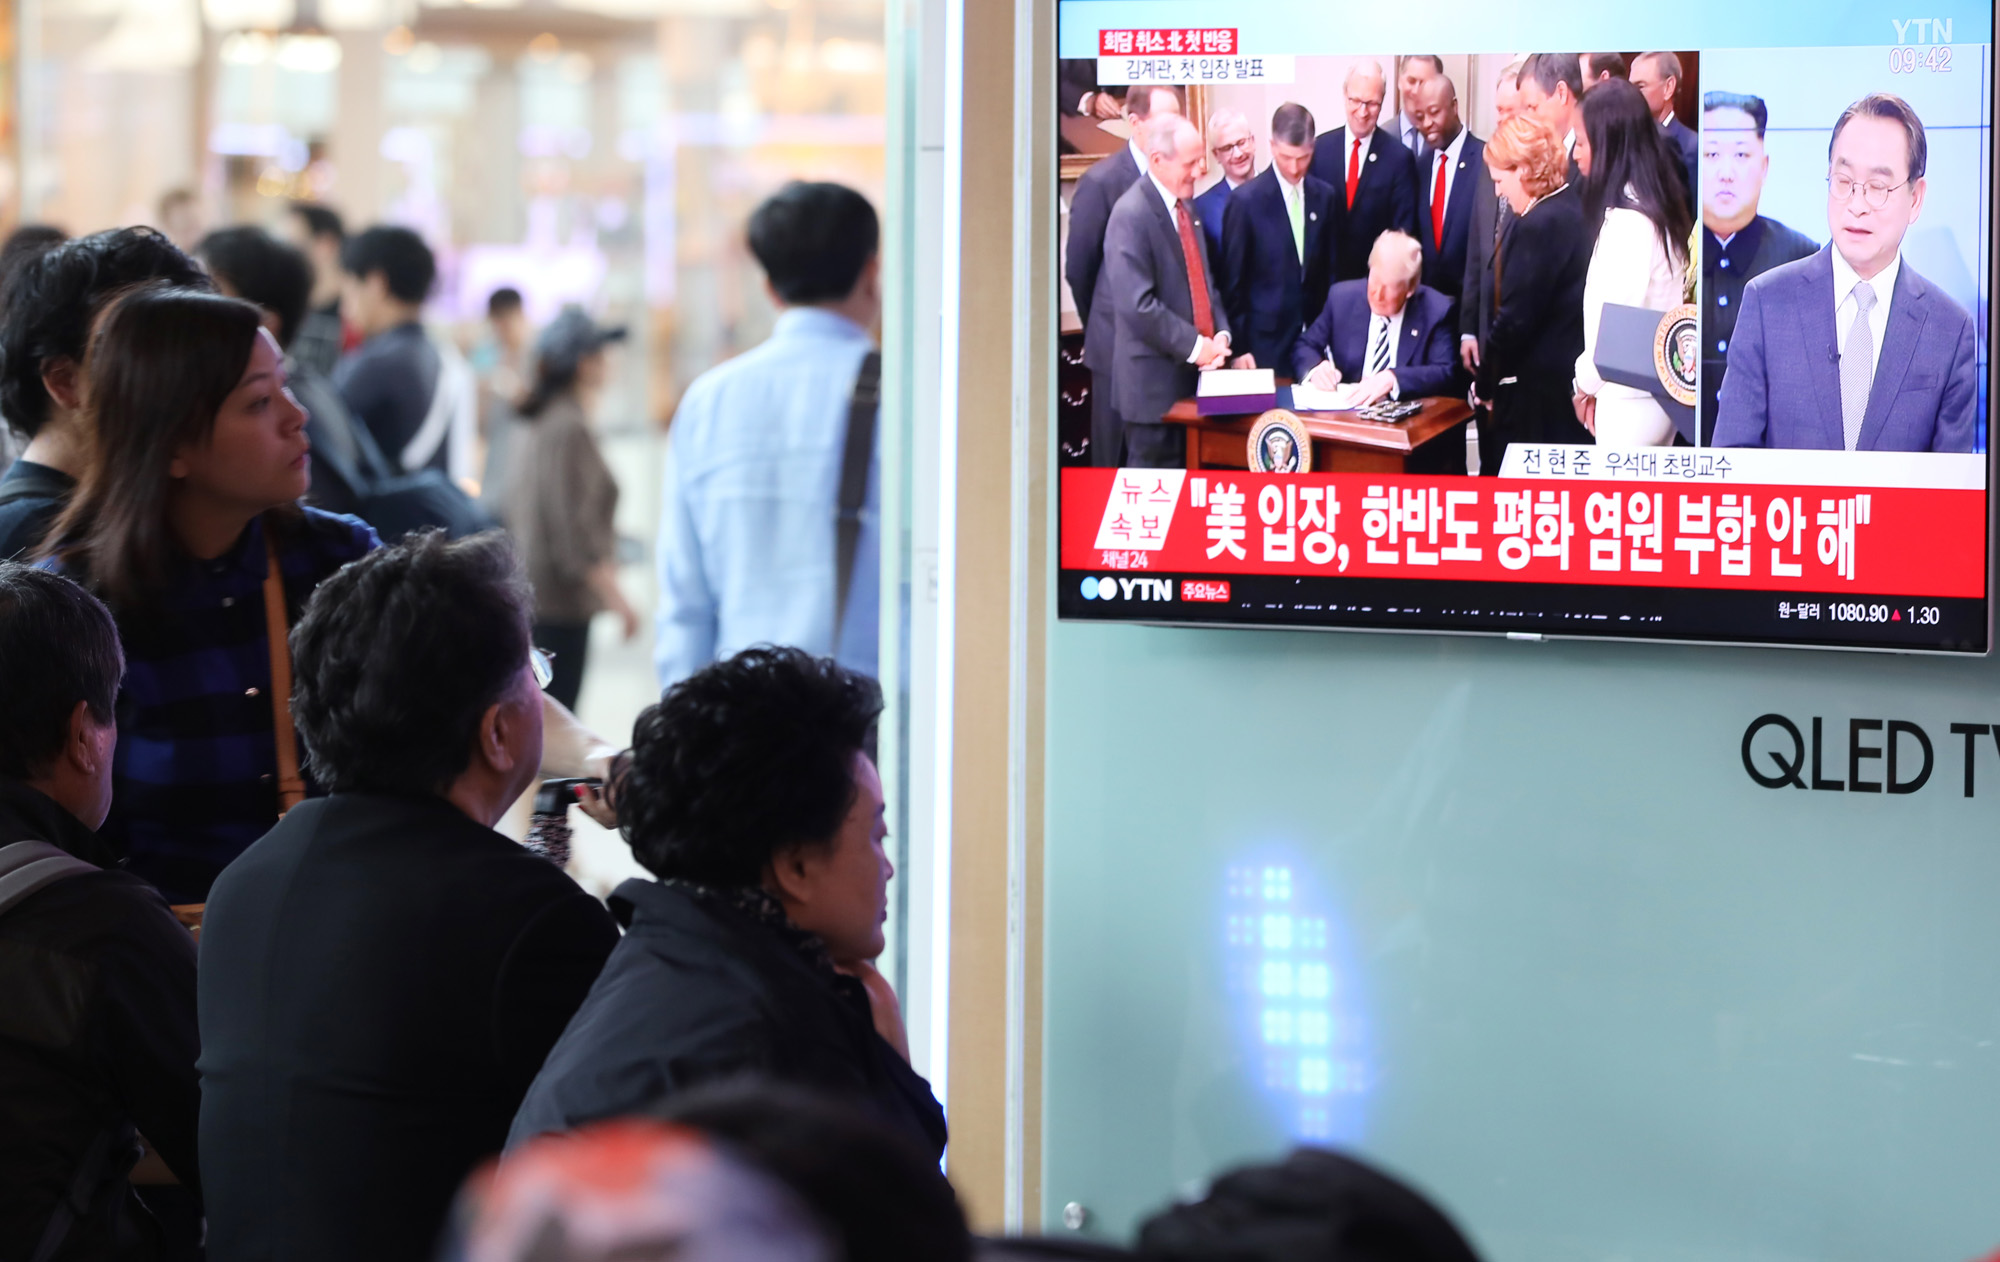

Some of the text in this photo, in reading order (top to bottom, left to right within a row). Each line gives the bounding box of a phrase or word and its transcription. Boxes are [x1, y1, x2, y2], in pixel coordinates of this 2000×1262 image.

[1103, 29, 1233, 53] 회담 취소 北 첫 반응
[1891, 17, 1953, 45] YTN
[1126, 58, 1265, 80] 김계관, 첫 입장 발표
[1889, 46, 1953, 74] 09:42
[1605, 451, 1657, 478] 우석대
[1662, 453, 1733, 479] 초빙교수
[1120, 477, 1172, 505] 뉴스
[1110, 512, 1162, 541] 속보
[1257, 484, 1350, 573] 입장,
[1361, 485, 1483, 566] 한반도
[1492, 489, 1575, 571] 평화
[1584, 491, 1663, 573] 염원
[1674, 494, 1757, 576] 부합
[1766, 497, 1807, 577] 안
[1101, 550, 1149, 569] 채널24
[1118, 577, 1173, 602] YTN
[1183, 583, 1229, 600] 주요뉴스
[1778, 601, 1940, 625] 원-달러 1080.90 1.30
[1741, 713, 2000, 798] QLED T
